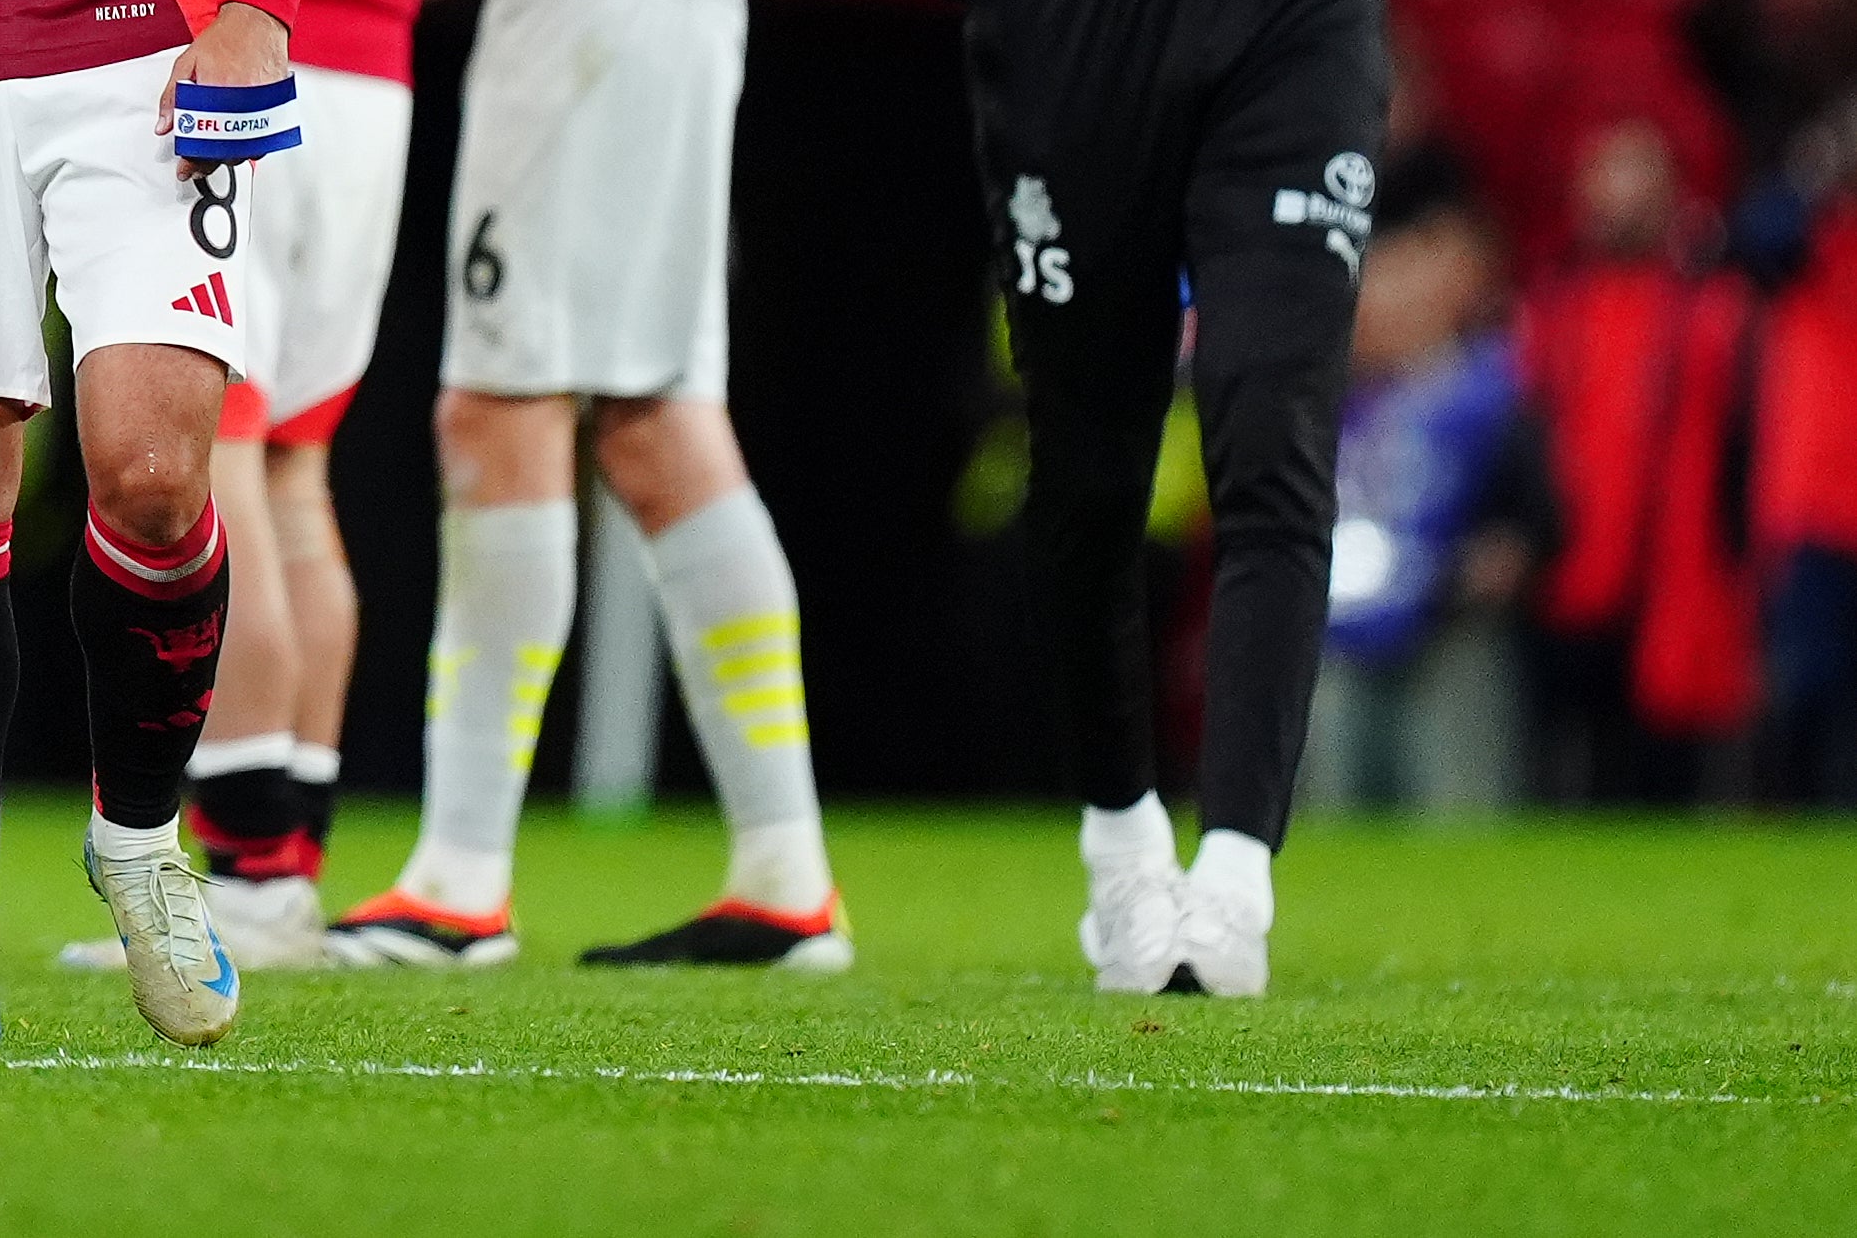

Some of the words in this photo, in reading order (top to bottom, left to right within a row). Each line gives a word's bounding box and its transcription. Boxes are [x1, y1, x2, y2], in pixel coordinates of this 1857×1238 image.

[197, 119, 220, 132] EFL
[224, 117, 270, 133] CAPTAIN
[190, 163, 238, 259] 8
[463, 210, 504, 300] 6
